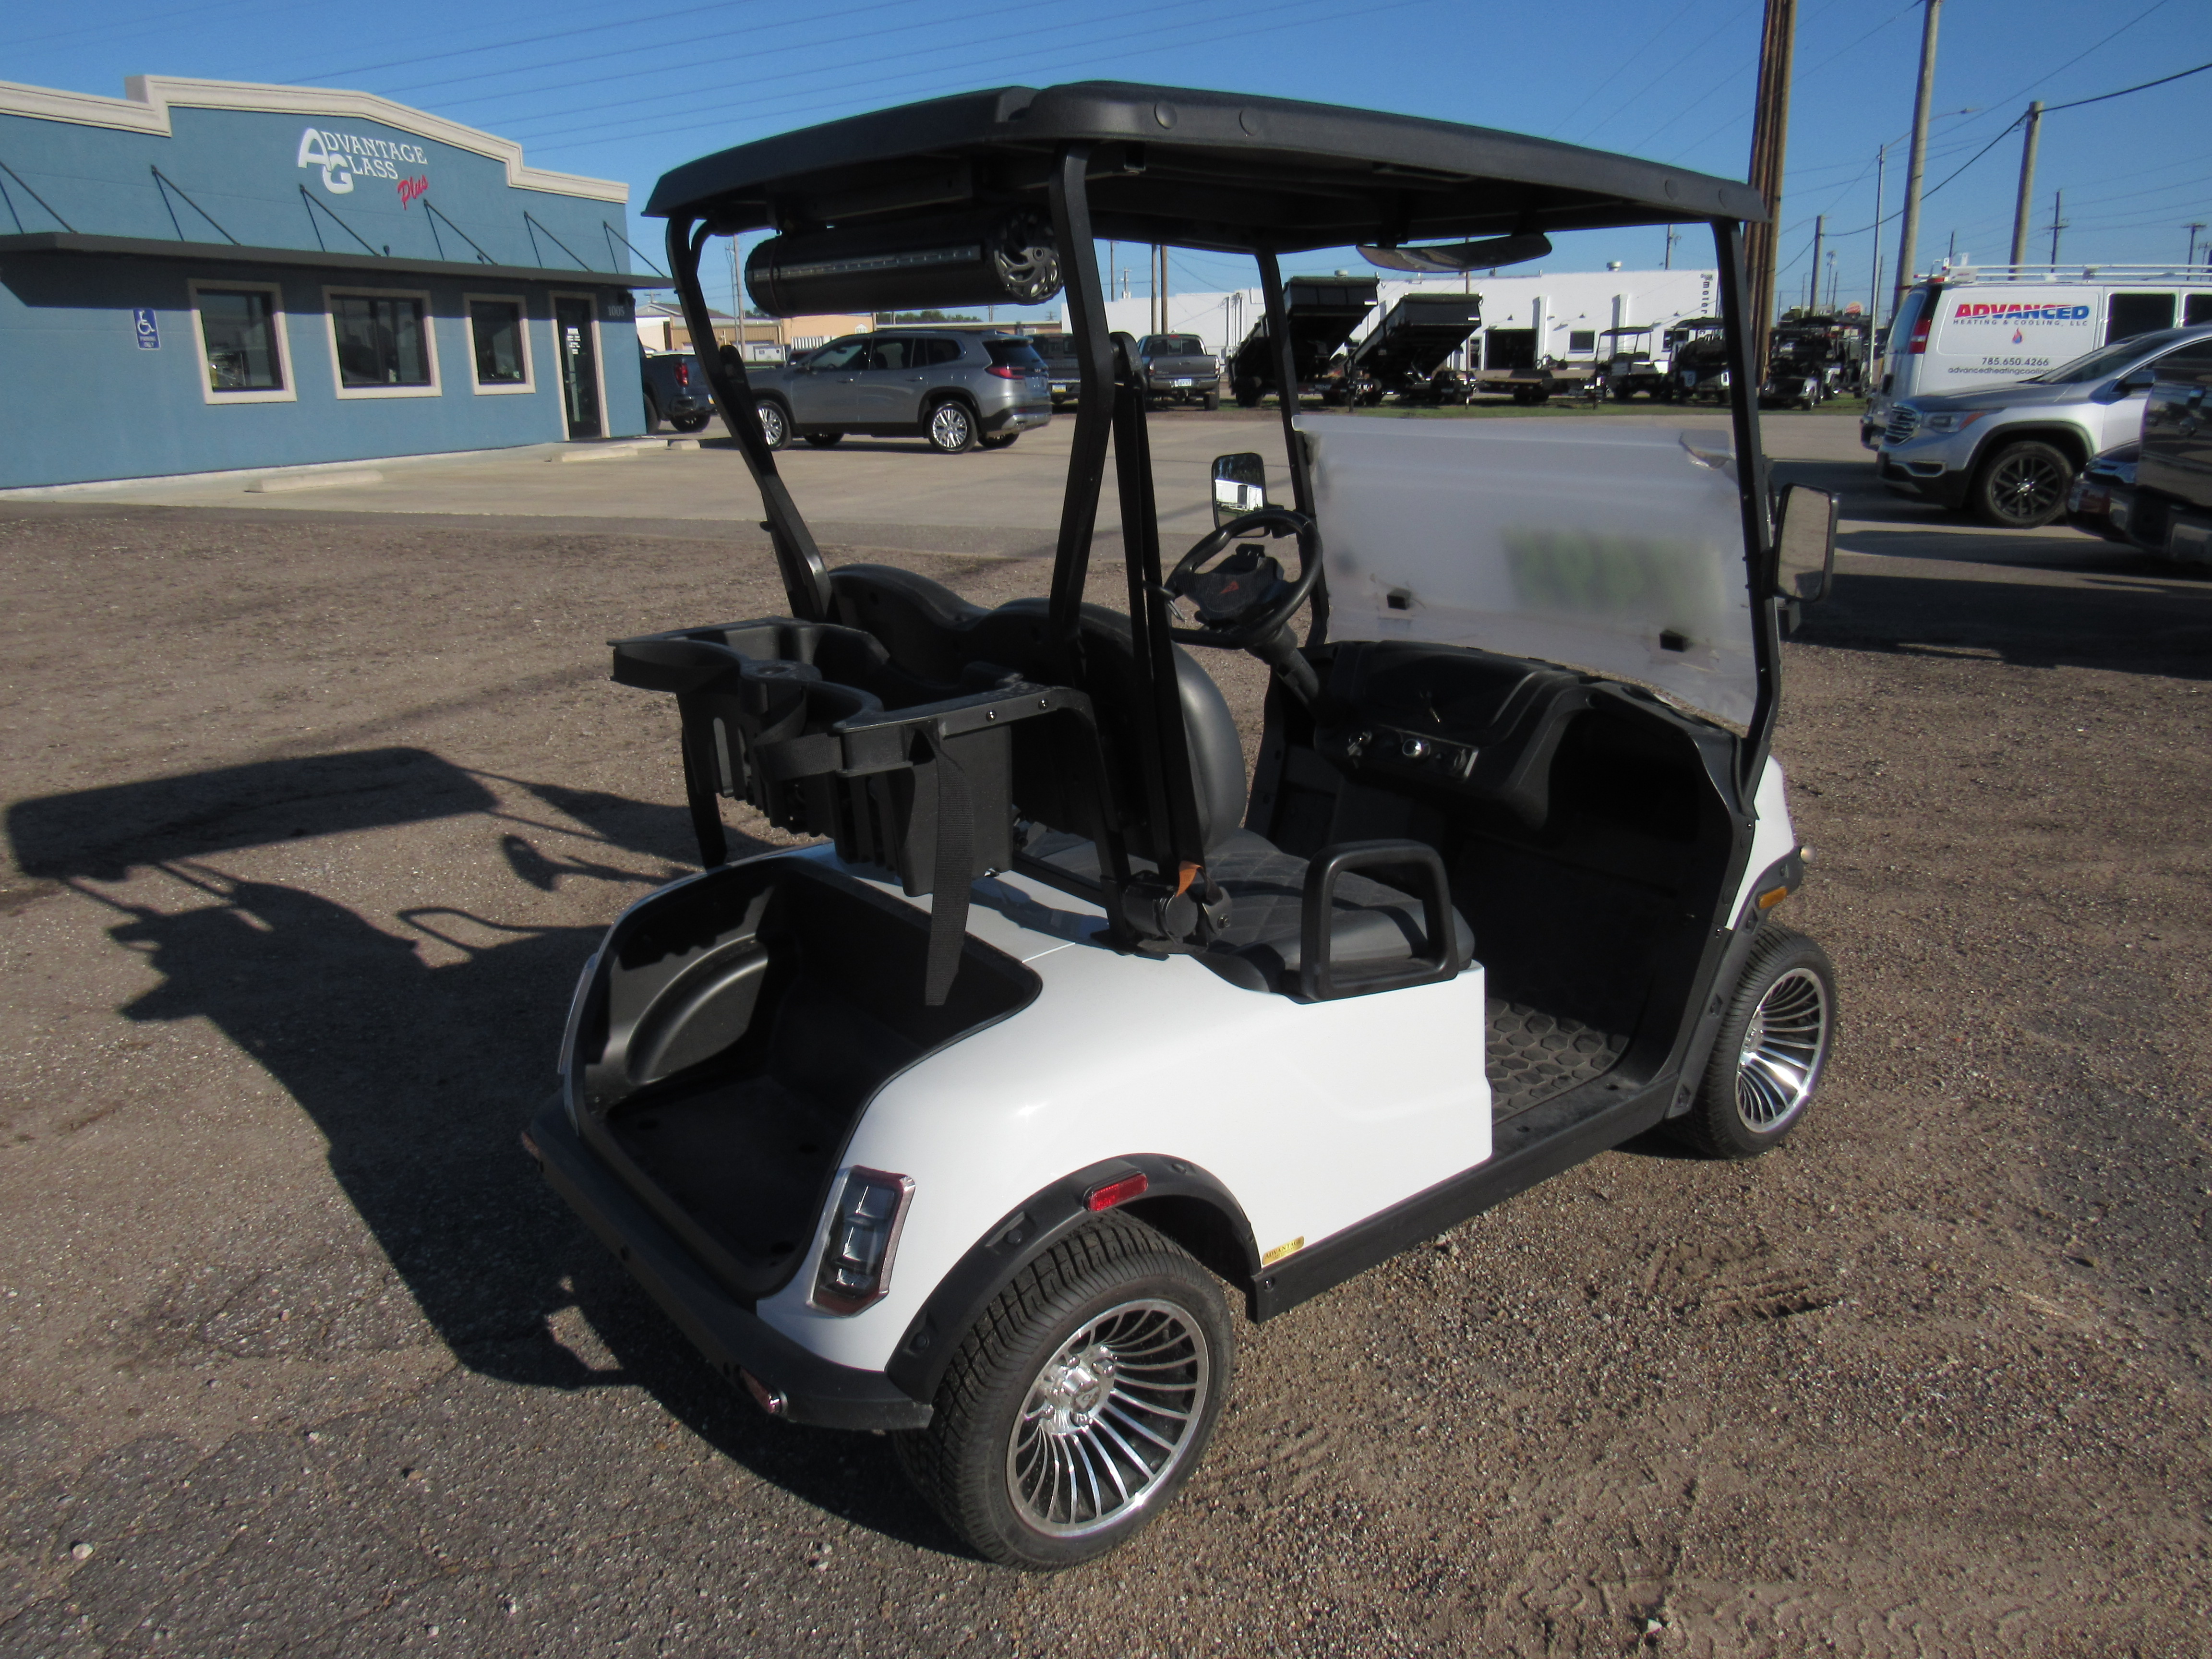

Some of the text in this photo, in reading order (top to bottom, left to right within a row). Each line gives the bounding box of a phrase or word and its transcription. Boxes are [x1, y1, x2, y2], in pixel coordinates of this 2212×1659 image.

[298, 128, 428, 172] ADVANTAGE
[323, 154, 398, 194] GLASS
[397, 175, 429, 210] Plus
[608, 306, 625, 316] 1005
[1954, 304, 2090, 320] ADVANCED
[1982, 357, 2049, 366] 785.650.4266
[1265, 1239, 1300, 1259] ADVANTAGE
